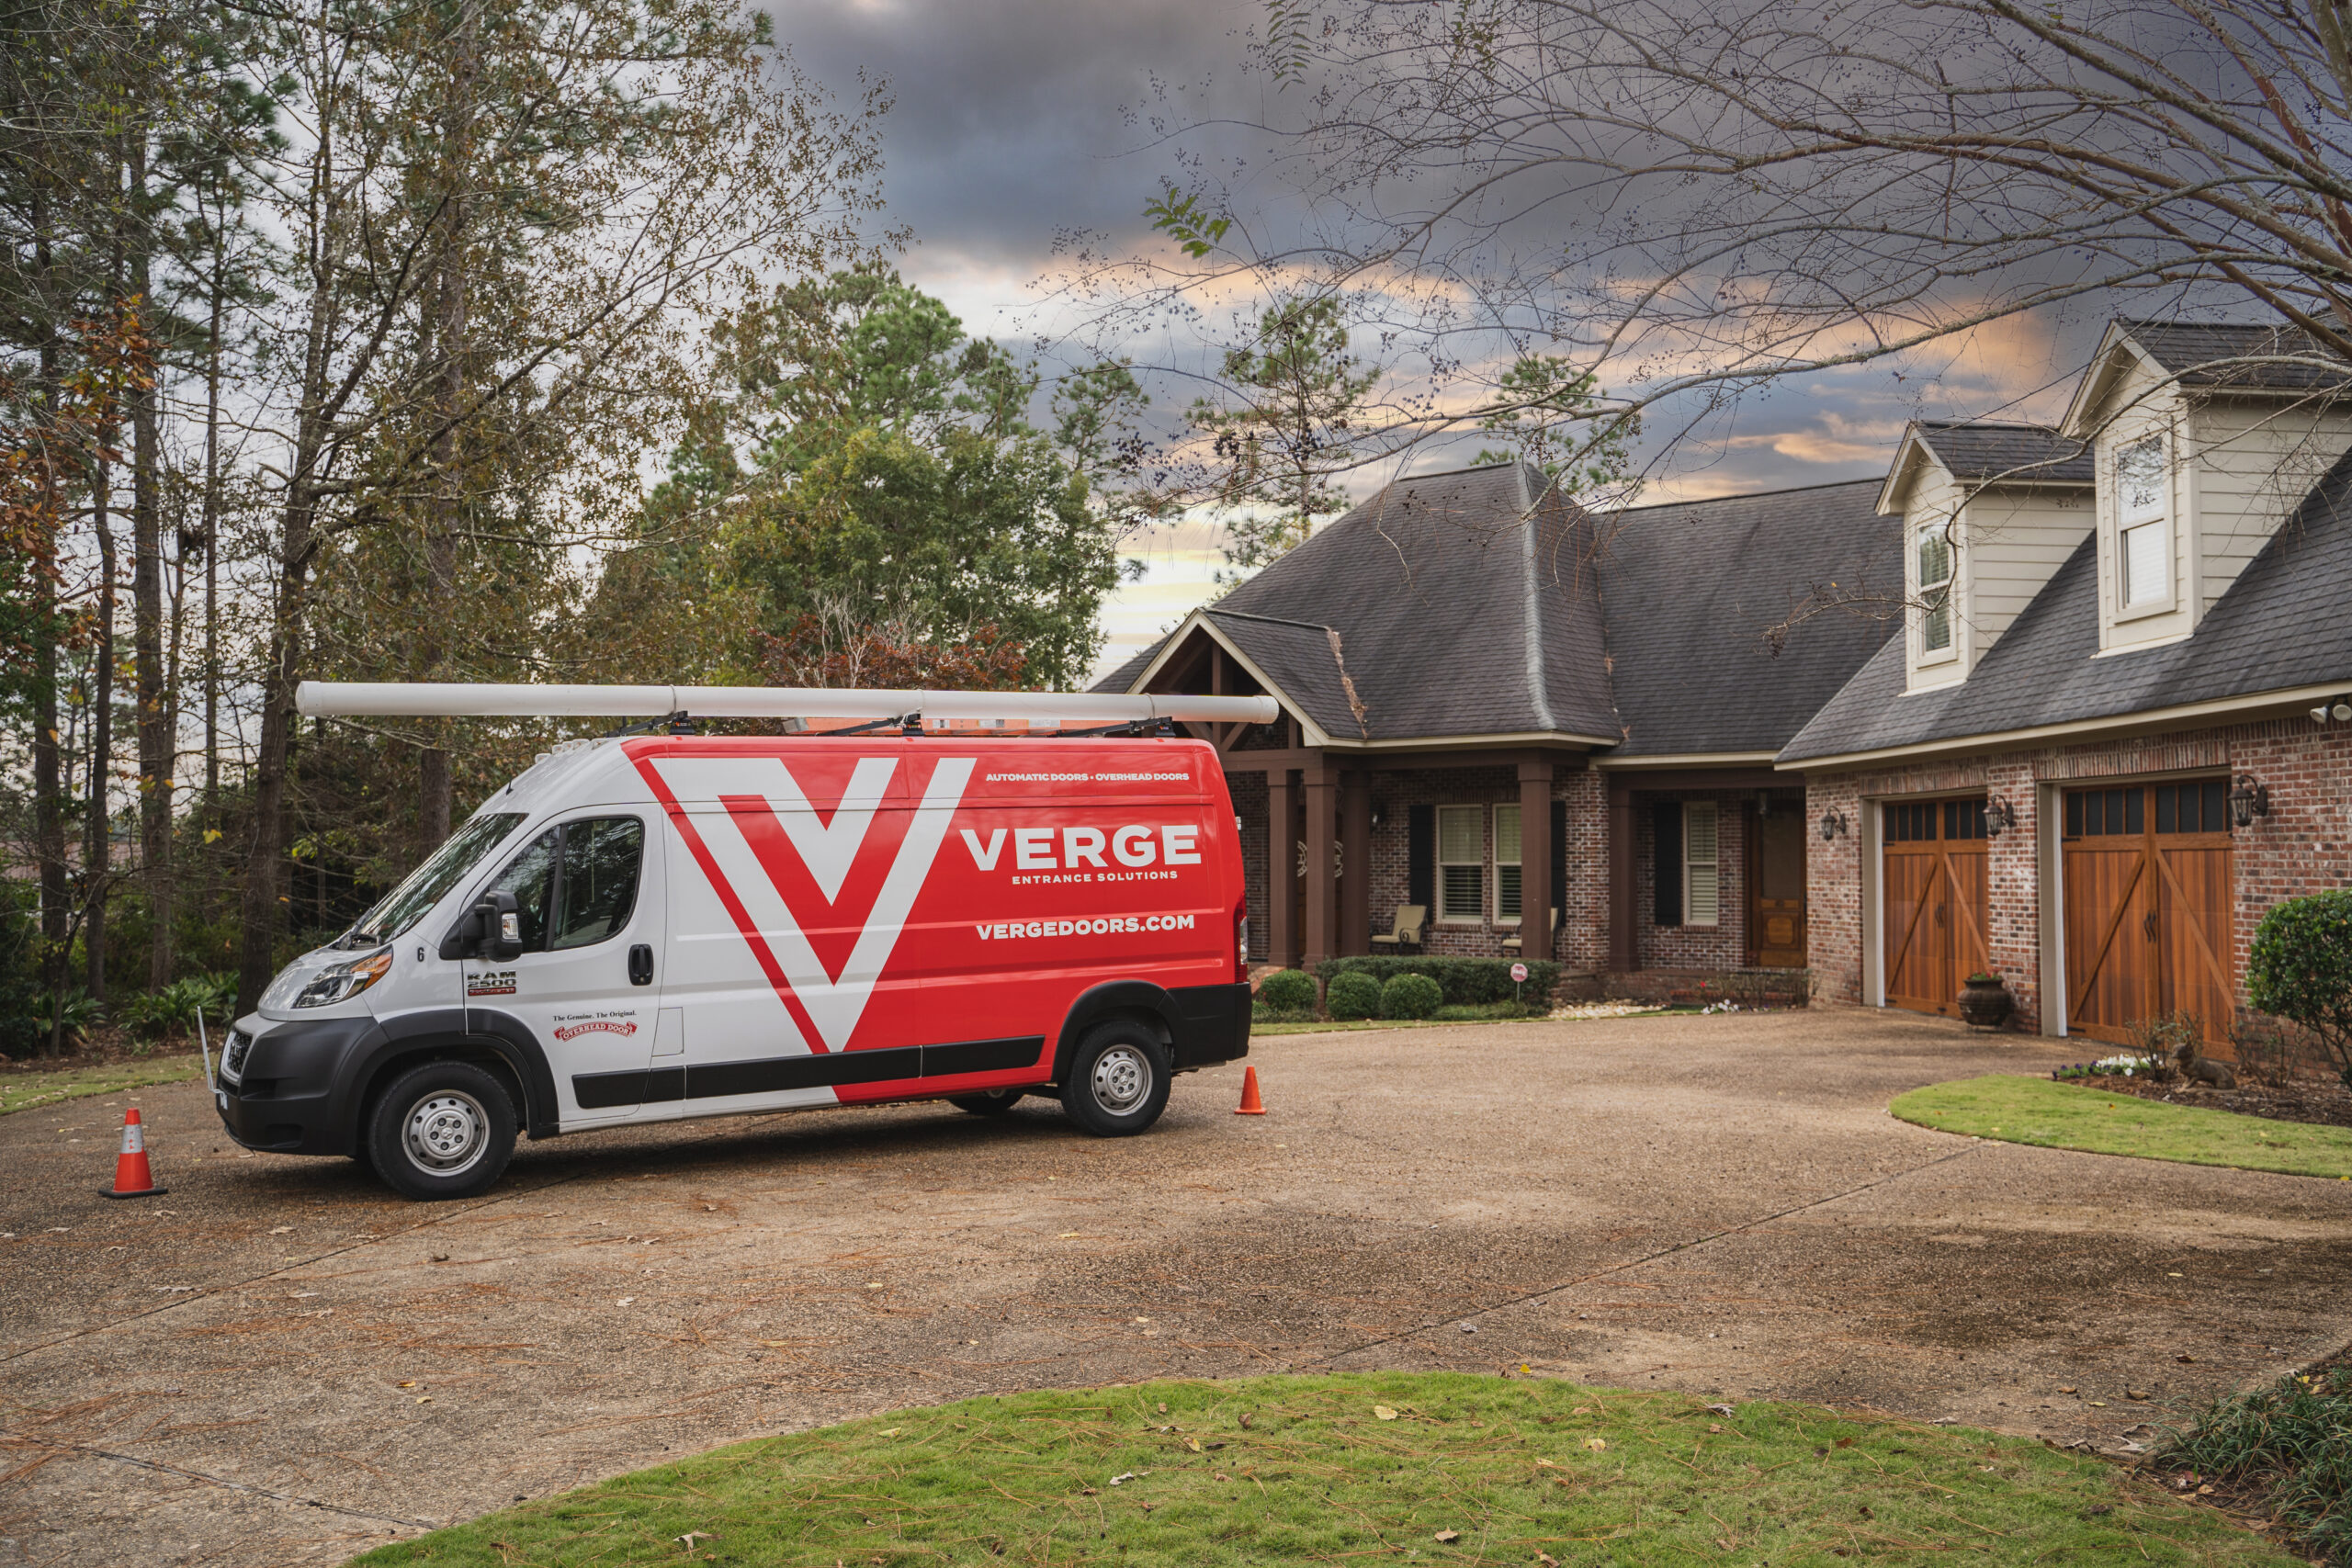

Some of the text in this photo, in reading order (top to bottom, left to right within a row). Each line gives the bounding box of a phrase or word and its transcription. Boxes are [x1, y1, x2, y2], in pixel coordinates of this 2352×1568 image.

[986, 773, 1189, 782] AUTOMATIC DOORS OVERHEAD DOORS
[959, 824, 1202, 871] VERGE
[1012, 871, 1178, 885] ENTRANCE SOLUTIONS
[977, 914, 1194, 940] VERGEDOORS.COM
[417, 946, 424, 963] 6
[467, 971, 516, 981] RAM
[467, 979, 516, 988] 2500
[562, 1023, 629, 1039] OVERHEAD DOOR
